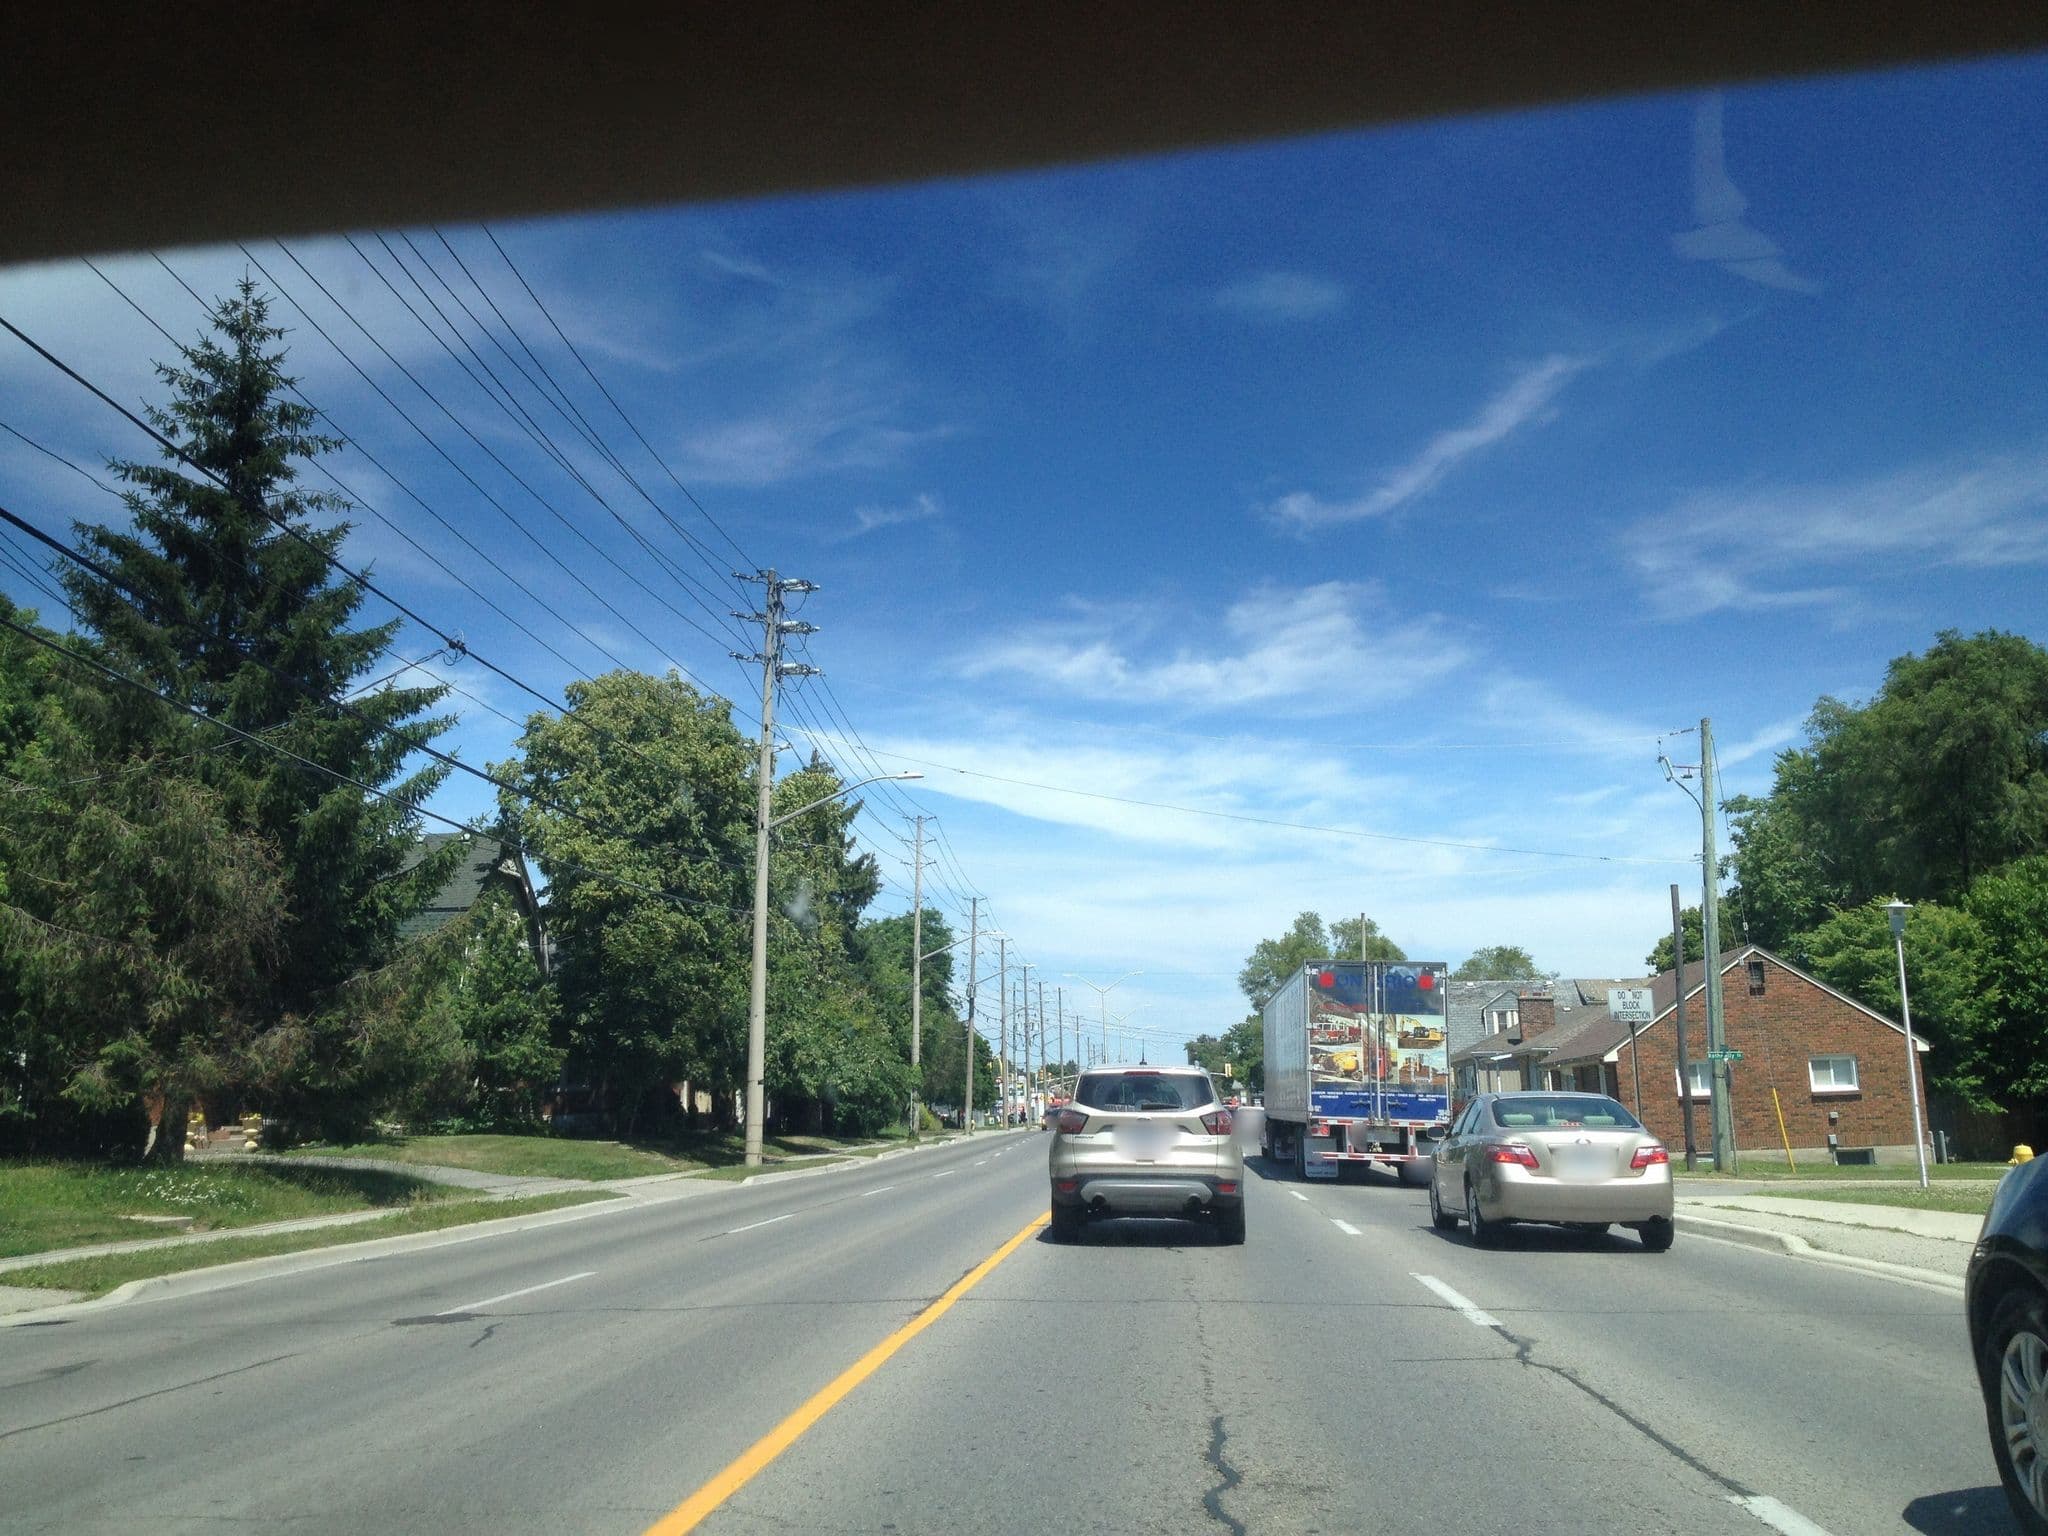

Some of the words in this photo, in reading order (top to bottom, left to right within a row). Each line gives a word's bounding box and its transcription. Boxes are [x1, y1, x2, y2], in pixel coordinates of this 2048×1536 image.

[1617, 991, 1626, 1000] DO
[1632, 991, 1643, 1000] NOT
[1622, 1001, 1641, 1010] BLOCK
[1613, 1011, 1651, 1020] INTERSECTION
